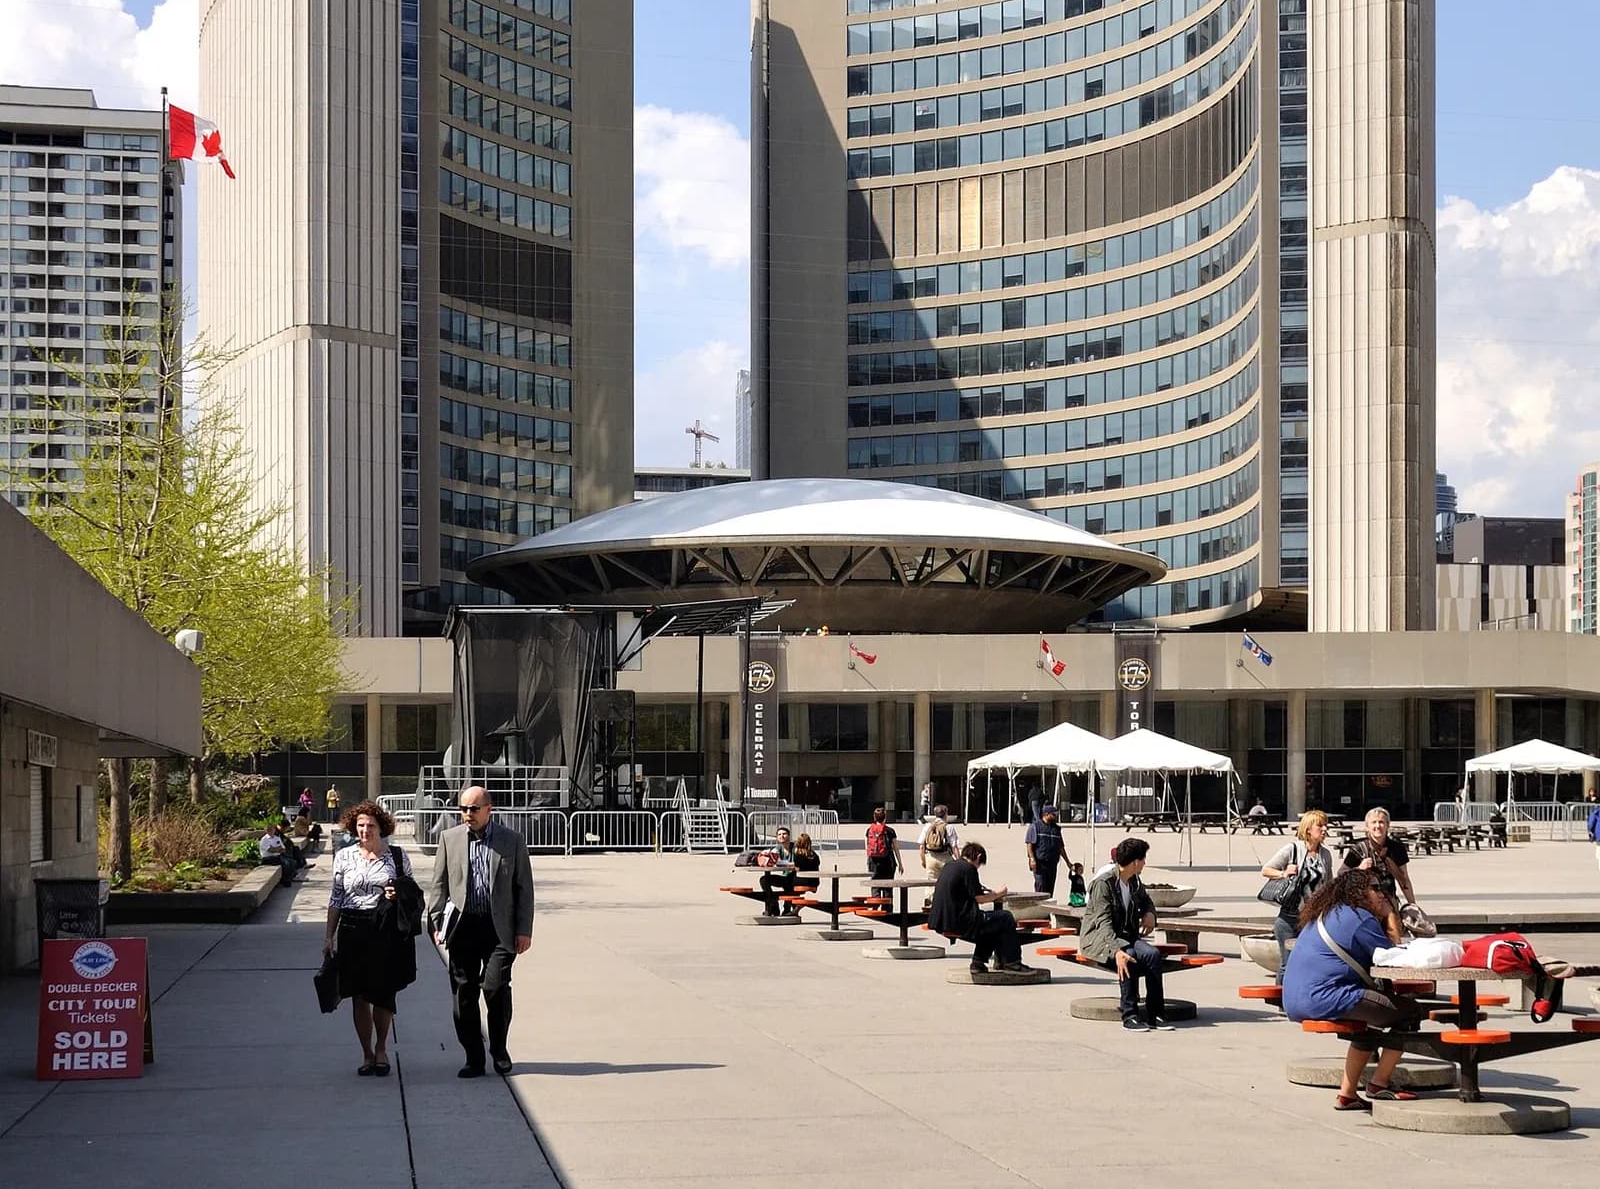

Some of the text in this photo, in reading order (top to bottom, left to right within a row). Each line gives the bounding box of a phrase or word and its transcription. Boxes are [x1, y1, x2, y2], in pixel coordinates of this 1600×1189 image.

[748, 669, 772, 687] 175
[1122, 666, 1147, 685] 175
[754, 703, 764, 775] CELEBRATE
[47, 982, 138, 993] DOUBLE DECKER
[48, 998, 137, 1011] CITY TOUR
[68, 1011, 117, 1024] Tickets
[54, 1030, 128, 1050] SOLD
[52, 1051, 127, 1071] HERE
